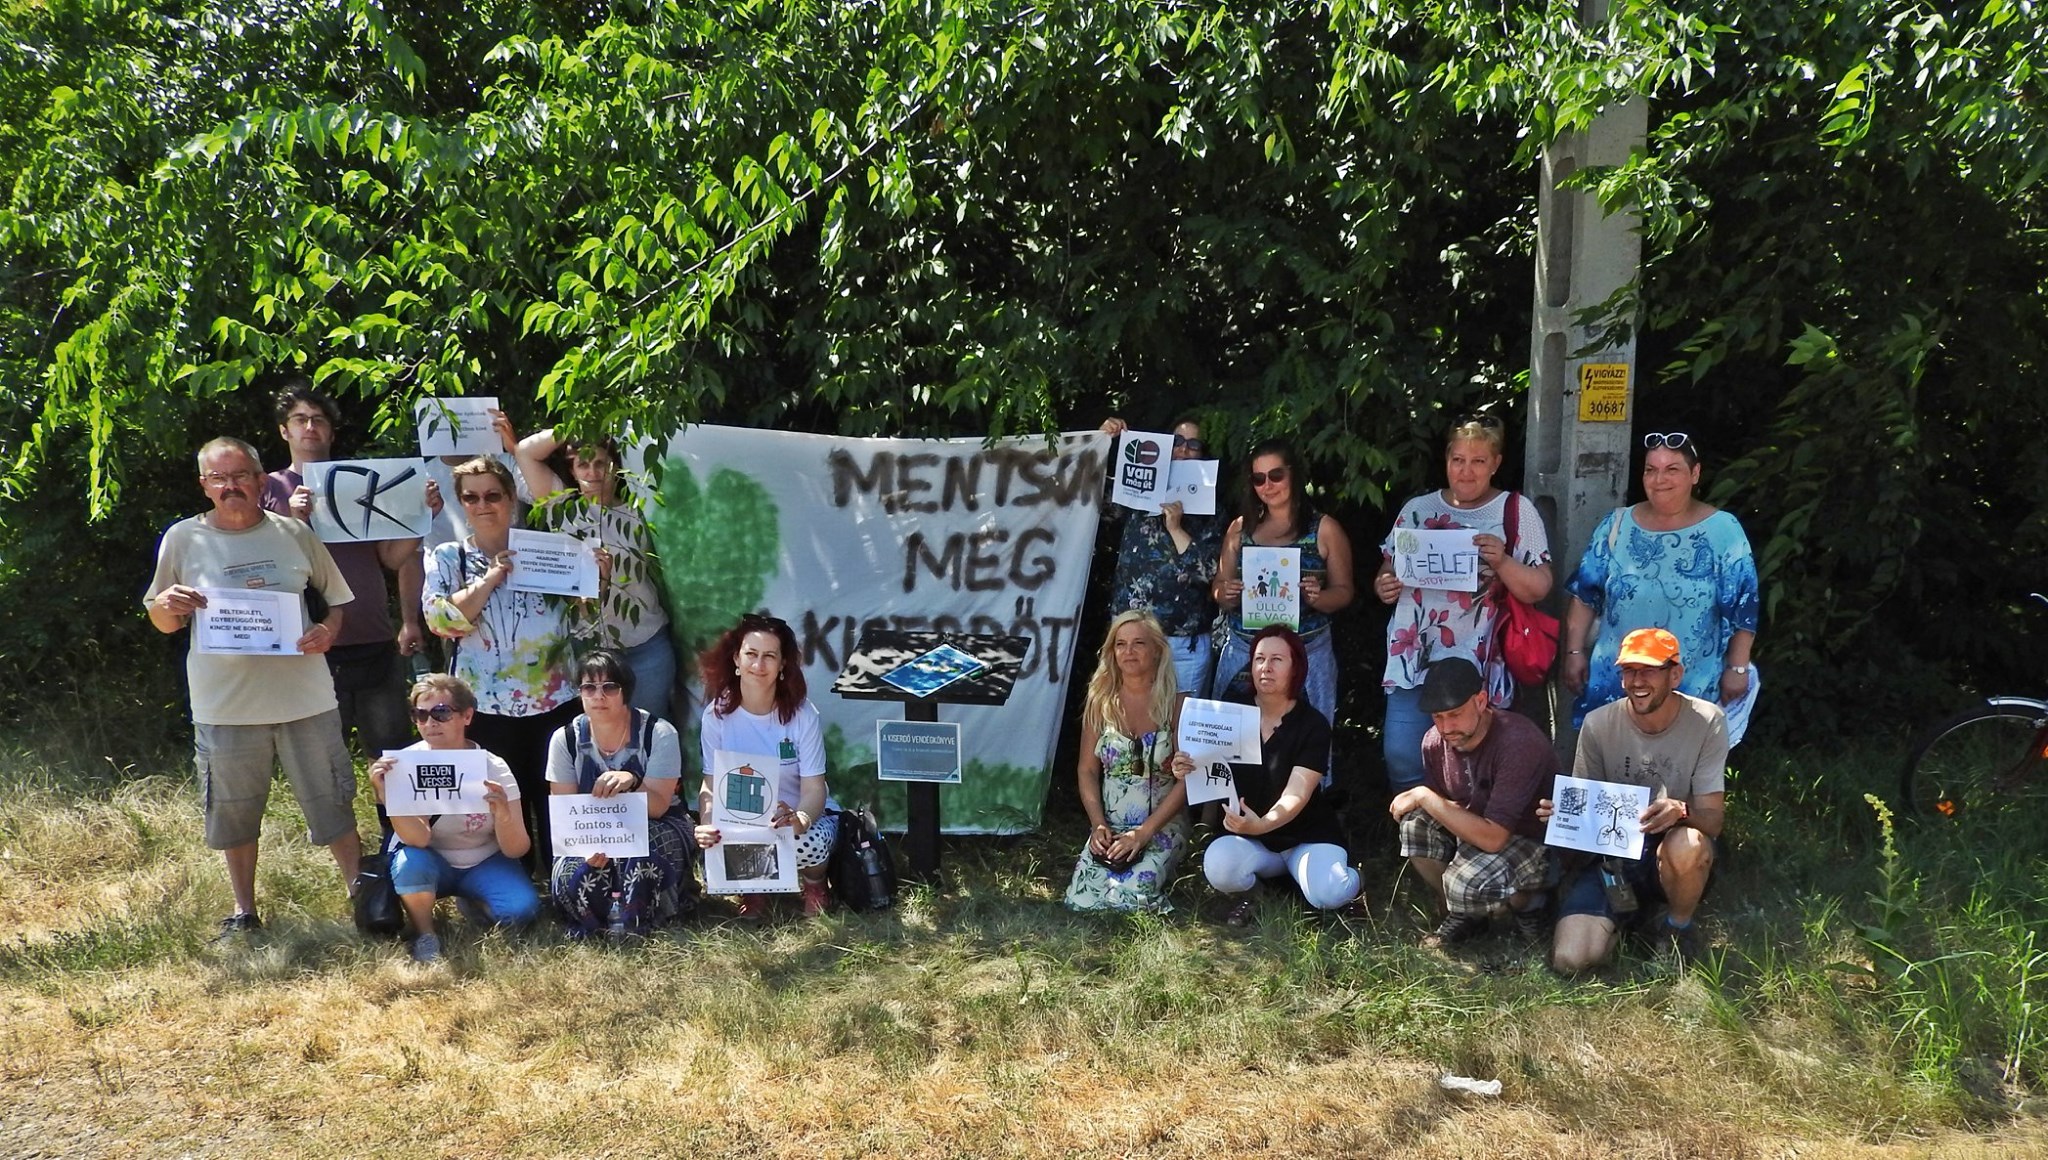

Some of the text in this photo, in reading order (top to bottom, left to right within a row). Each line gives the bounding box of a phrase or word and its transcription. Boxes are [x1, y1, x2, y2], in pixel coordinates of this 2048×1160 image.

[1590, 401, 1625, 416] 30687
[1126, 466, 1153, 480] van
[902, 527, 1056, 593] MEG
[1419, 576, 1444, 585] STOP
[1248, 612, 1295, 621] TE VAGY
[420, 766, 451, 776] ELEVEN
[421, 776, 452, 787] VECSÉS
[569, 803, 628, 815] A kiserdő
[574, 820, 624, 830] fontos a
[564, 833, 635, 847] gyáliaknak!
